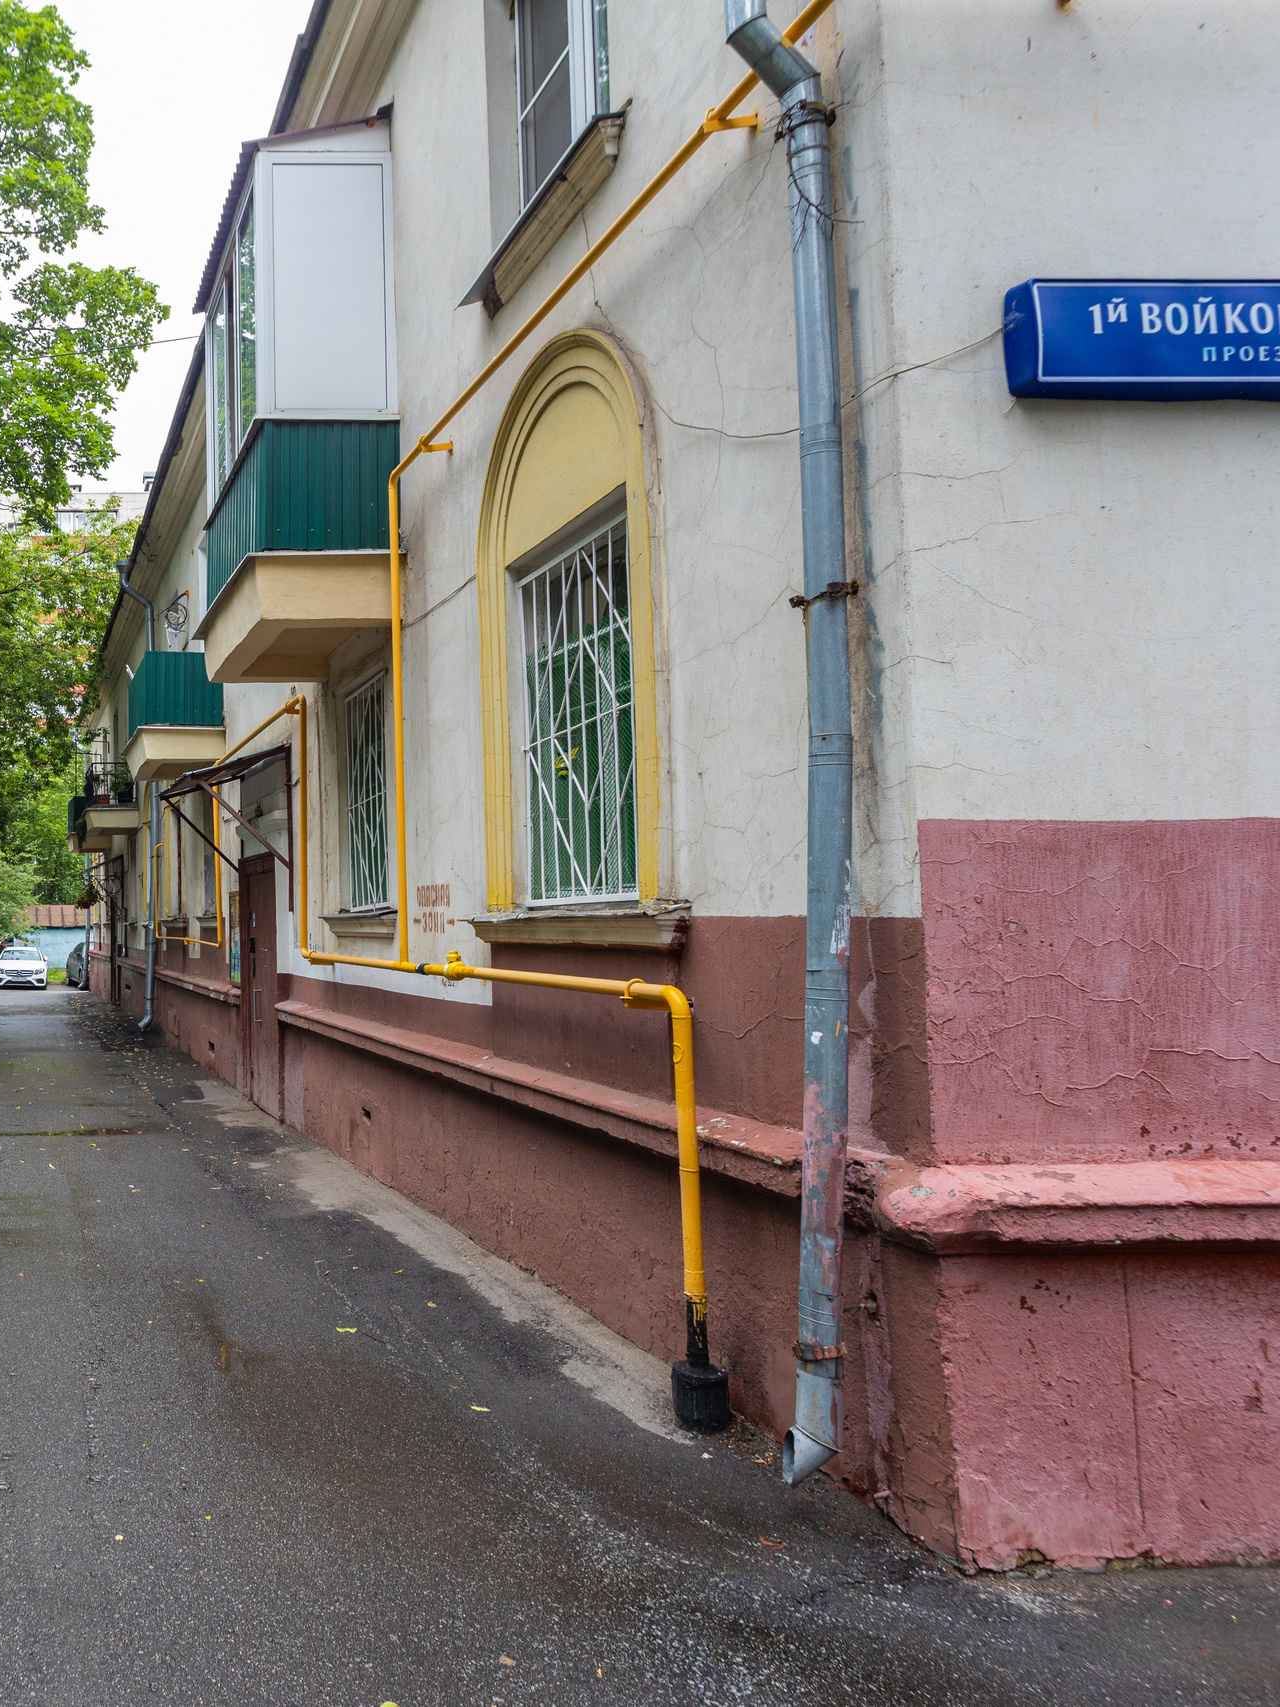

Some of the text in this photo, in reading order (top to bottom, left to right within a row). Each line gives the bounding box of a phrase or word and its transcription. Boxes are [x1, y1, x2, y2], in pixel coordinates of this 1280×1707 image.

[1140, 296, 1280, 336] ВОЙКО
[416, 883, 451, 908] ОПАСНАЯ
[422, 911, 445, 934] ЗОНА
